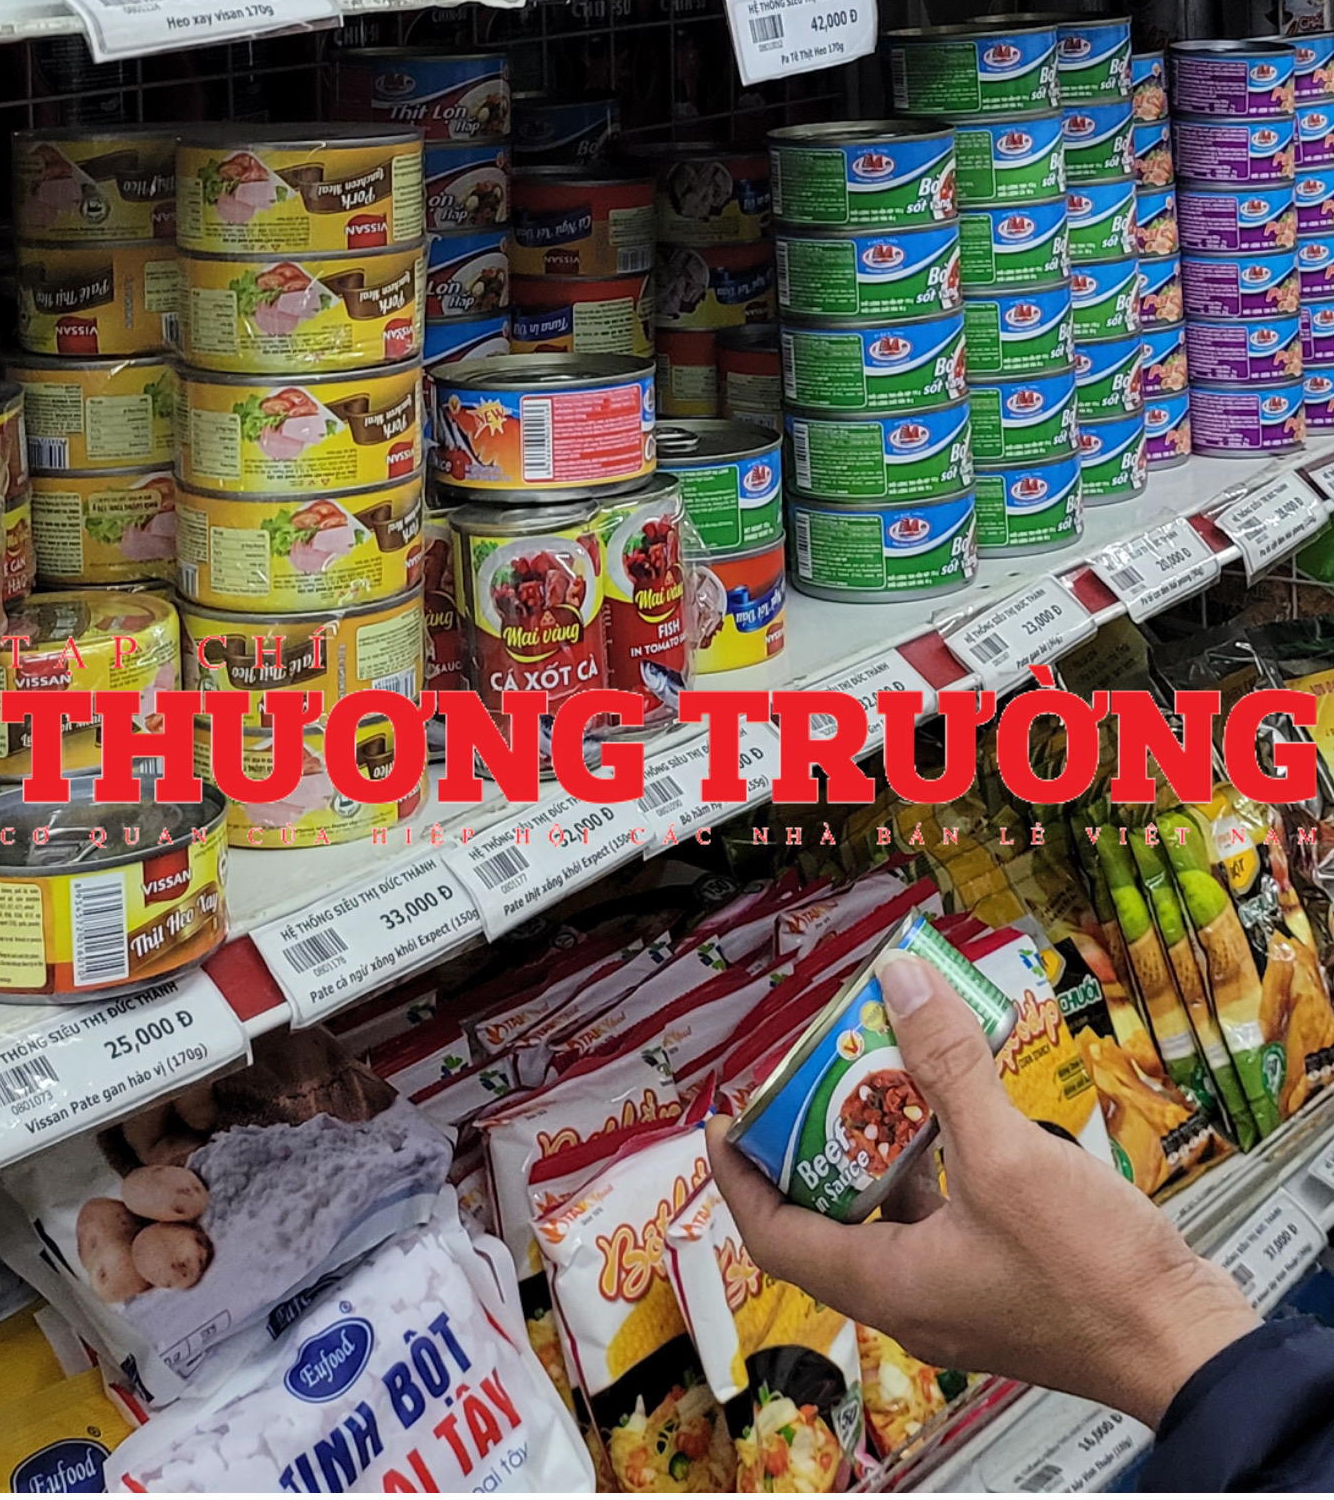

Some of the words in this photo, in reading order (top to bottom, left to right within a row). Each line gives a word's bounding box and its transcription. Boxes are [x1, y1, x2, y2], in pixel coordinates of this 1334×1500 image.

[167, 14, 190, 30] Heo
[193, 12, 213, 27] xay
[245, 4, 274, 17] 170g
[811, 10, 847, 33] 42,000
[850, 9, 858, 23] Đ
[476, 406, 507, 431] NEW
[503, 627, 540, 648] Mai
[543, 622, 580, 644] vàng
[631, 647, 642, 658] IN
[658, 618, 680, 639] FISH
[490, 667, 518, 691] CÁ
[524, 662, 572, 691] XỐT
[577, 653, 598, 681] CÀ
[140, 868, 193, 899] VISSAN
[379, 891, 438, 930] 33,000
[437, 884, 453, 900] Đ
[129, 923, 166, 960] Thịt
[166, 905, 196, 940] Heo
[197, 888, 220, 920] Xay
[310, 984, 335, 1004] Pate
[336, 974, 349, 988] cá
[349, 963, 370, 984] ngừ
[371, 954, 396, 973] xông
[395, 941, 418, 958] khói
[419, 923, 451, 946] Expect
[48, 1019, 81, 1045] SIÊU
[80, 1012, 107, 1033] THỊ
[108, 997, 137, 1019] ĐỨC
[134, 979, 179, 1007] THÀNH
[103, 1017, 176, 1060] 25,000
[175, 1009, 193, 1028] Đ
[10, 1090, 54, 1116] 0801073
[24, 1105, 69, 1135] Vissan
[71, 1094, 101, 1115] Pate
[102, 1083, 127, 1102] gan
[127, 1070, 152, 1089] hào
[153, 1060, 167, 1079] vị
[166, 1042, 208, 1073] (170g)
[796, 1116, 853, 1191] Beef
[811, 1187, 831, 1213] in
[825, 1149, 870, 1202] Sauce
[300, 1328, 356, 1388] Eufood
[381, 1312, 472, 1430] BỘT
[433, 1367, 522, 1478] TÂY
